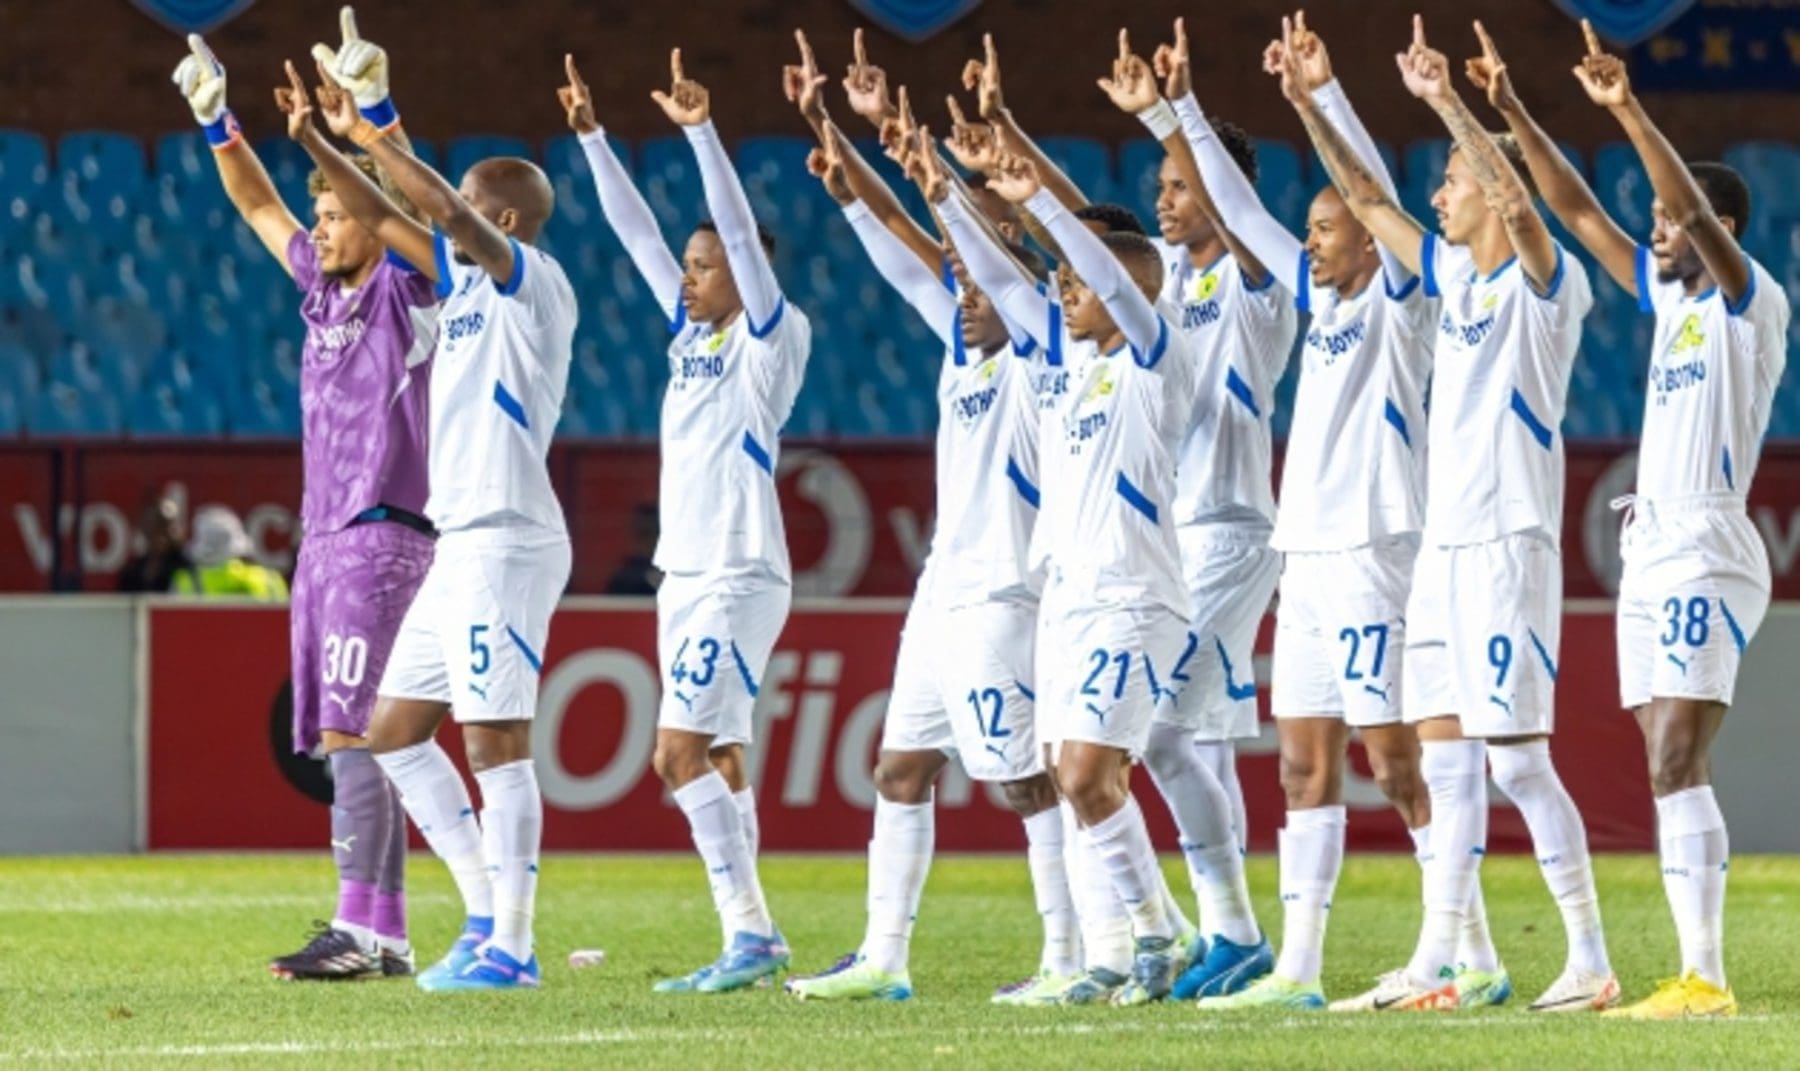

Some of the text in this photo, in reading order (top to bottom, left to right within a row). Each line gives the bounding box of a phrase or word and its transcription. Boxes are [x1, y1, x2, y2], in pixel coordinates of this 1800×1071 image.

[1661, 596, 1710, 647] 38
[322, 633, 367, 687] 30
[470, 624, 491, 675] 5
[671, 636, 720, 686] 43
[1080, 647, 1131, 700] 21
[1339, 624, 1389, 680] 27
[1488, 633, 1512, 688] 9
[967, 687, 1012, 738] 12
